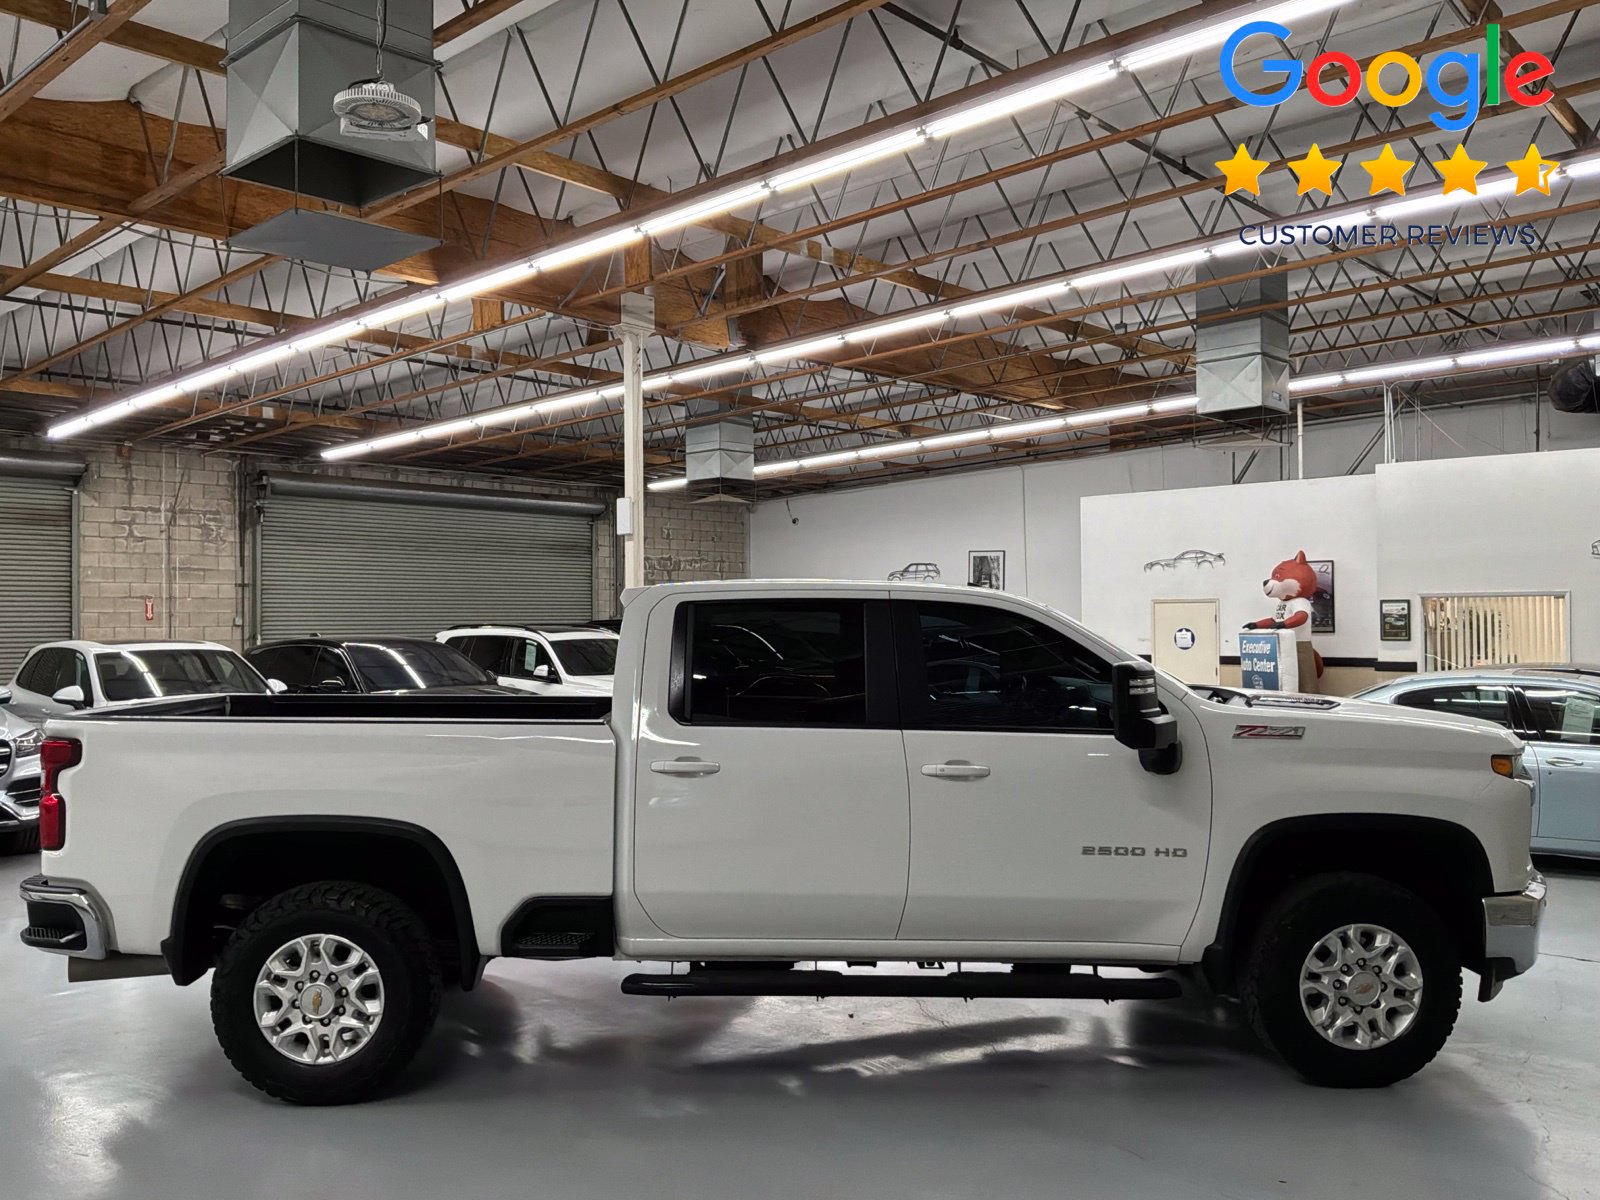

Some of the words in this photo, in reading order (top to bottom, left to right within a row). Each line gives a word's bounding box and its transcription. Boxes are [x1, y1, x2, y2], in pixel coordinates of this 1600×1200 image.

[1242, 640, 1271, 654] Executive
[1241, 658, 1252, 671] uto
[1252, 658, 1276, 672] Center
[1082, 846, 1146, 857] 2500
[1154, 847, 1188, 858] HD
